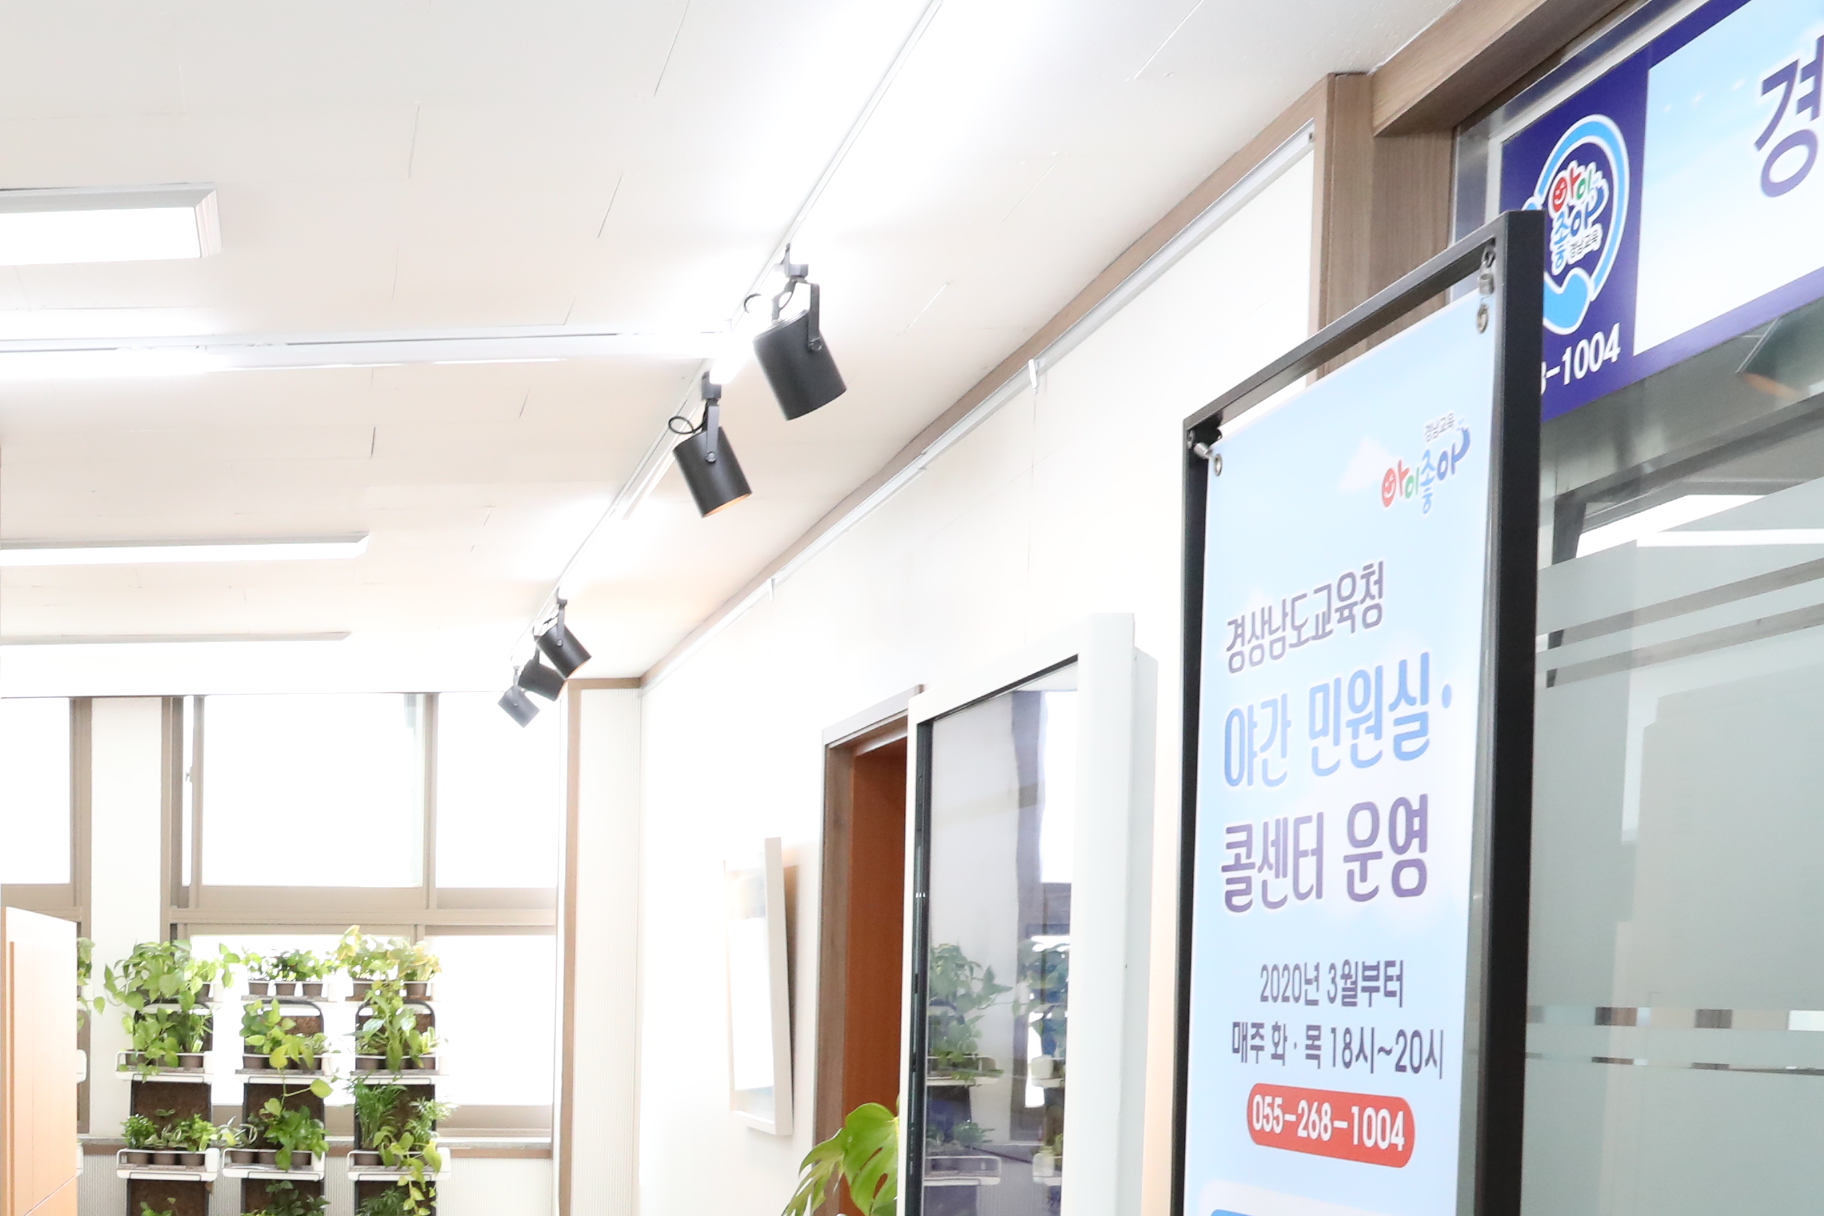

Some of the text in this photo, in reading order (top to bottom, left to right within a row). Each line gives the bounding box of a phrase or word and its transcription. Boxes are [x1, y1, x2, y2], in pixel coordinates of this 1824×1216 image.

[1754, 35, 1824, 198] 경
[1225, 560, 1385, 675] 경상남도교육청
[1223, 692, 1292, 788] 야간
[1221, 793, 1429, 914] 콜센터 운영
[1259, 958, 1405, 1009] 2020년 3월부터
[1232, 1020, 1266, 1065] 매주
[1330, 1026, 1445, 1080] 18시~20시
[1252, 1093, 1406, 1152] 055-268-1004
